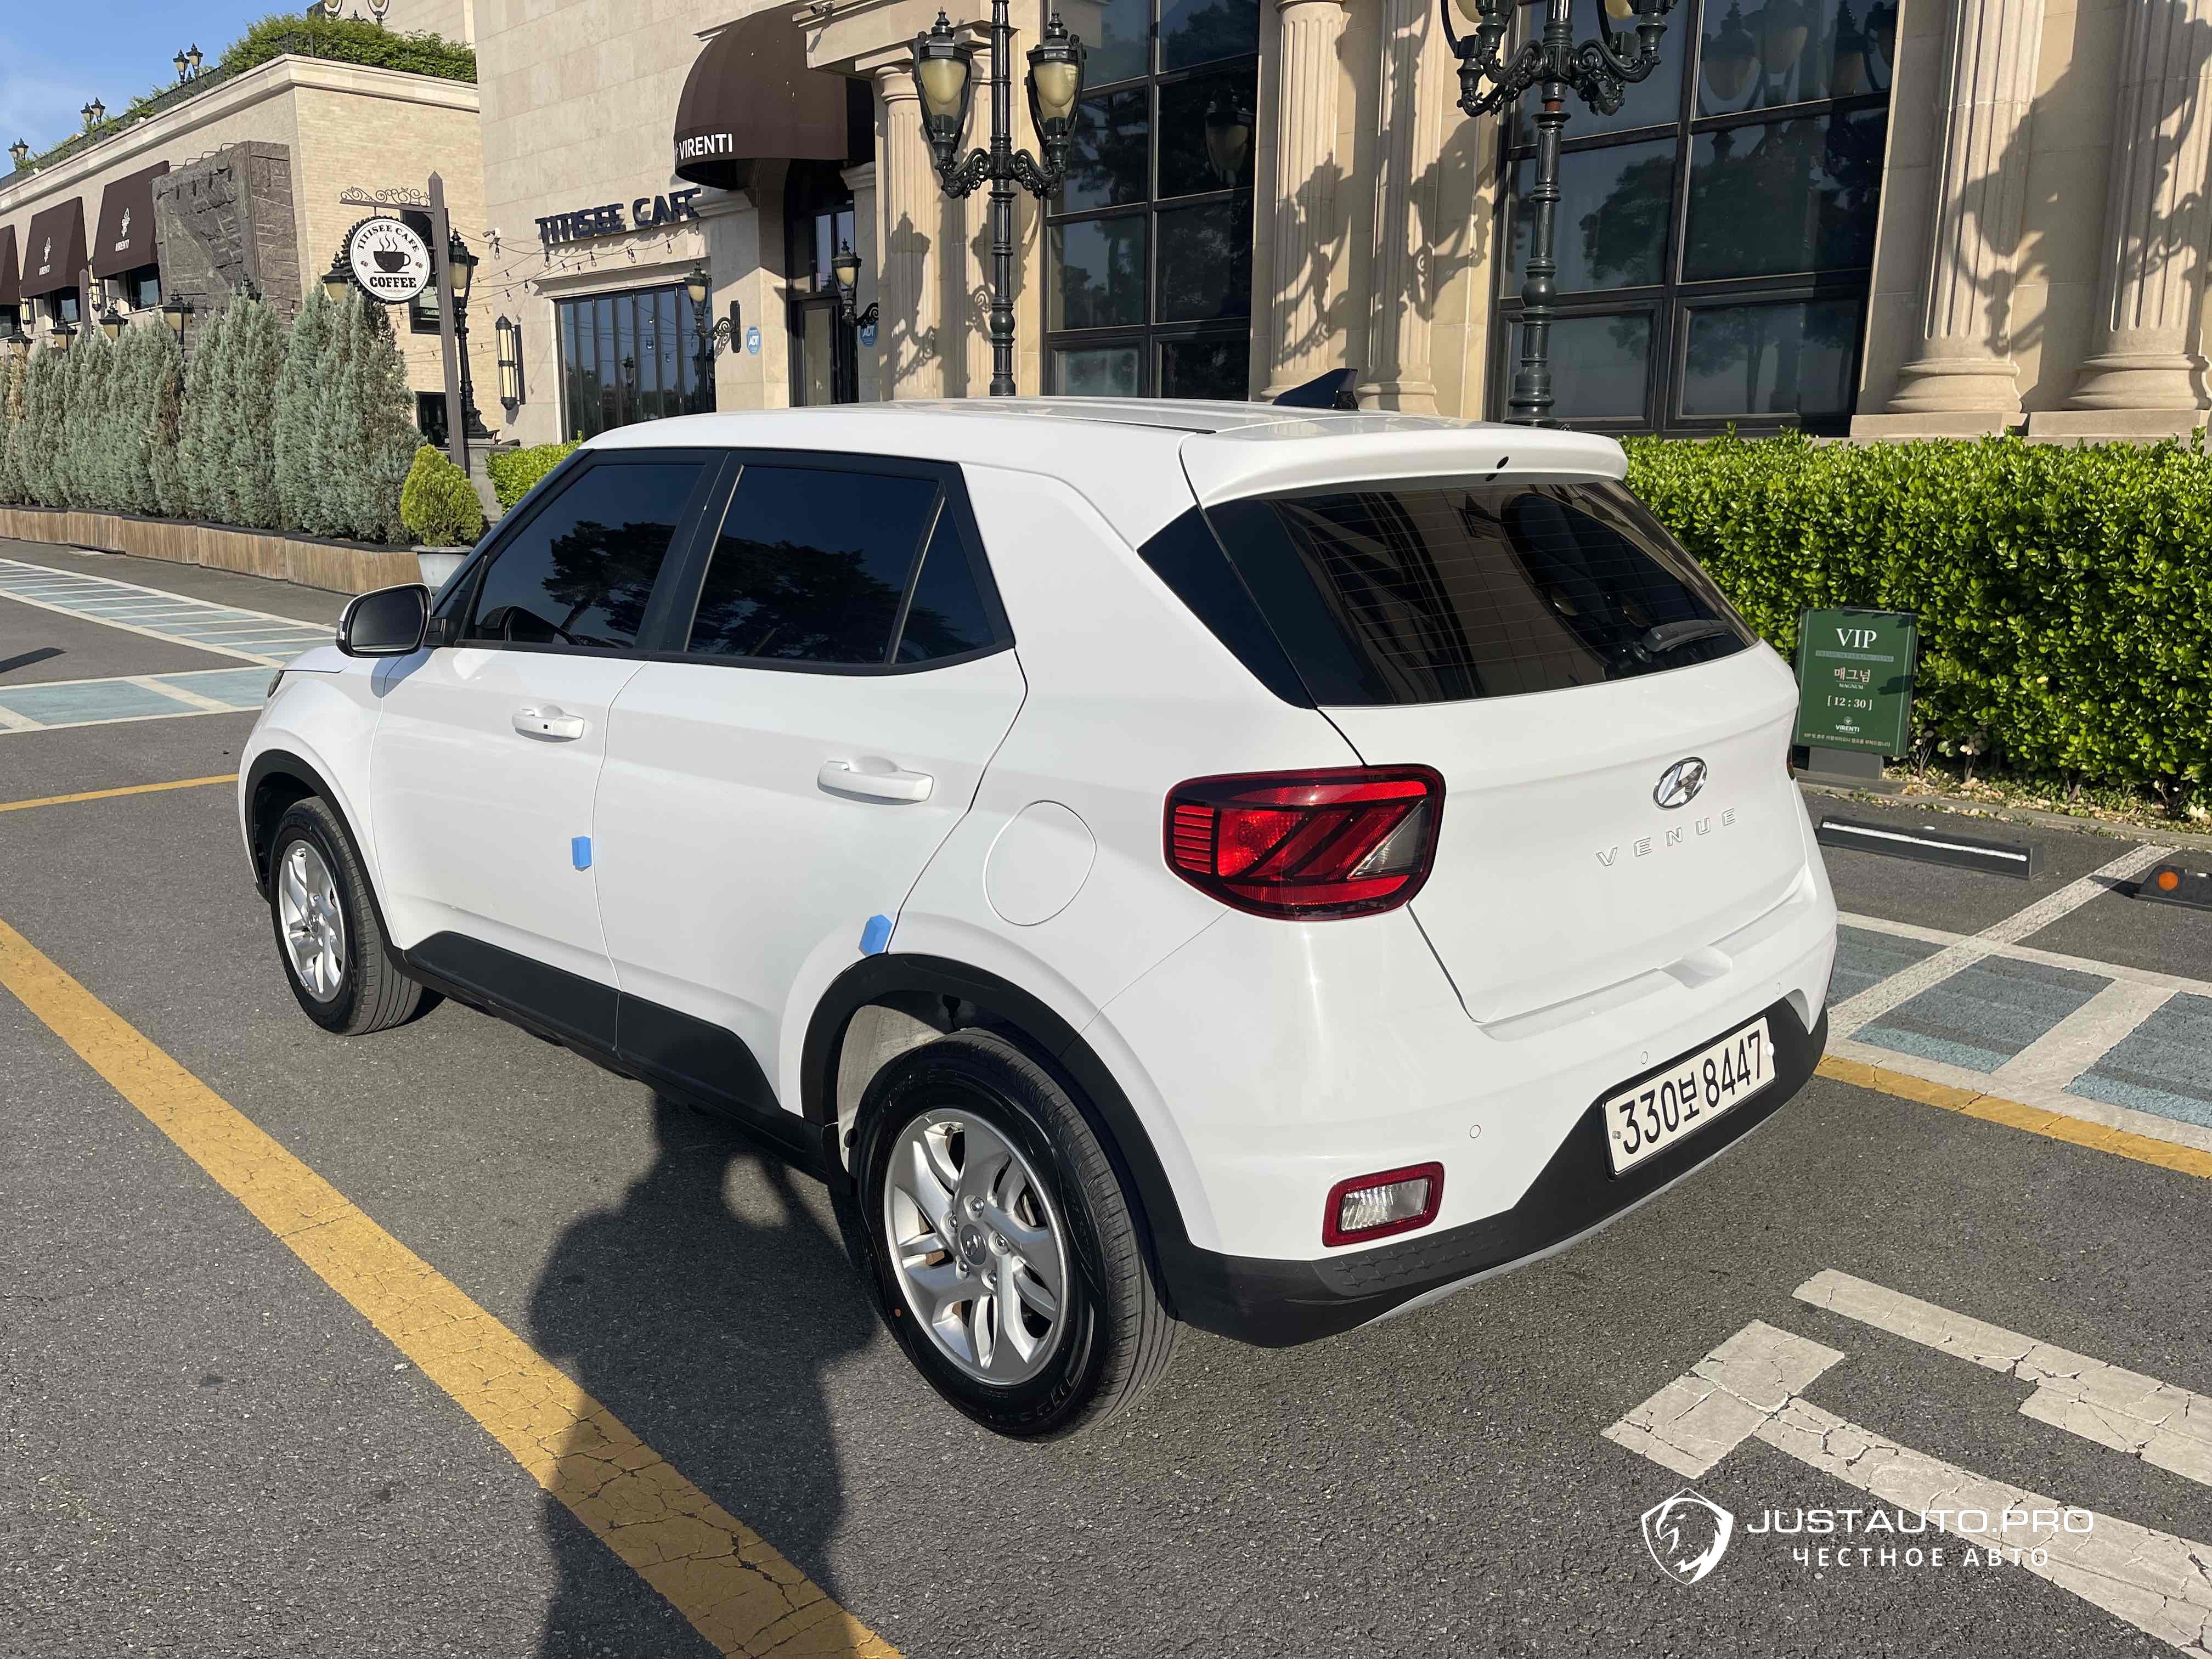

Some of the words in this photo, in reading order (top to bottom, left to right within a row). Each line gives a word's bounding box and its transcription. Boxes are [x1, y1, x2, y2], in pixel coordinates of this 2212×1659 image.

[679, 133, 733, 160] VIRENTI
[535, 203, 627, 245] TITISEE
[357, 224, 392, 250] TITISEE
[395, 227, 420, 252] CAFE
[369, 276, 417, 288] COFFEE
[748, 335, 759, 346] ADT
[1835, 628, 1877, 648] VIP
[1834, 667, 1871, 683] 매그넘
[1835, 724, 1860, 733] VIRENTI
[1595, 808, 1735, 867] VENUE
